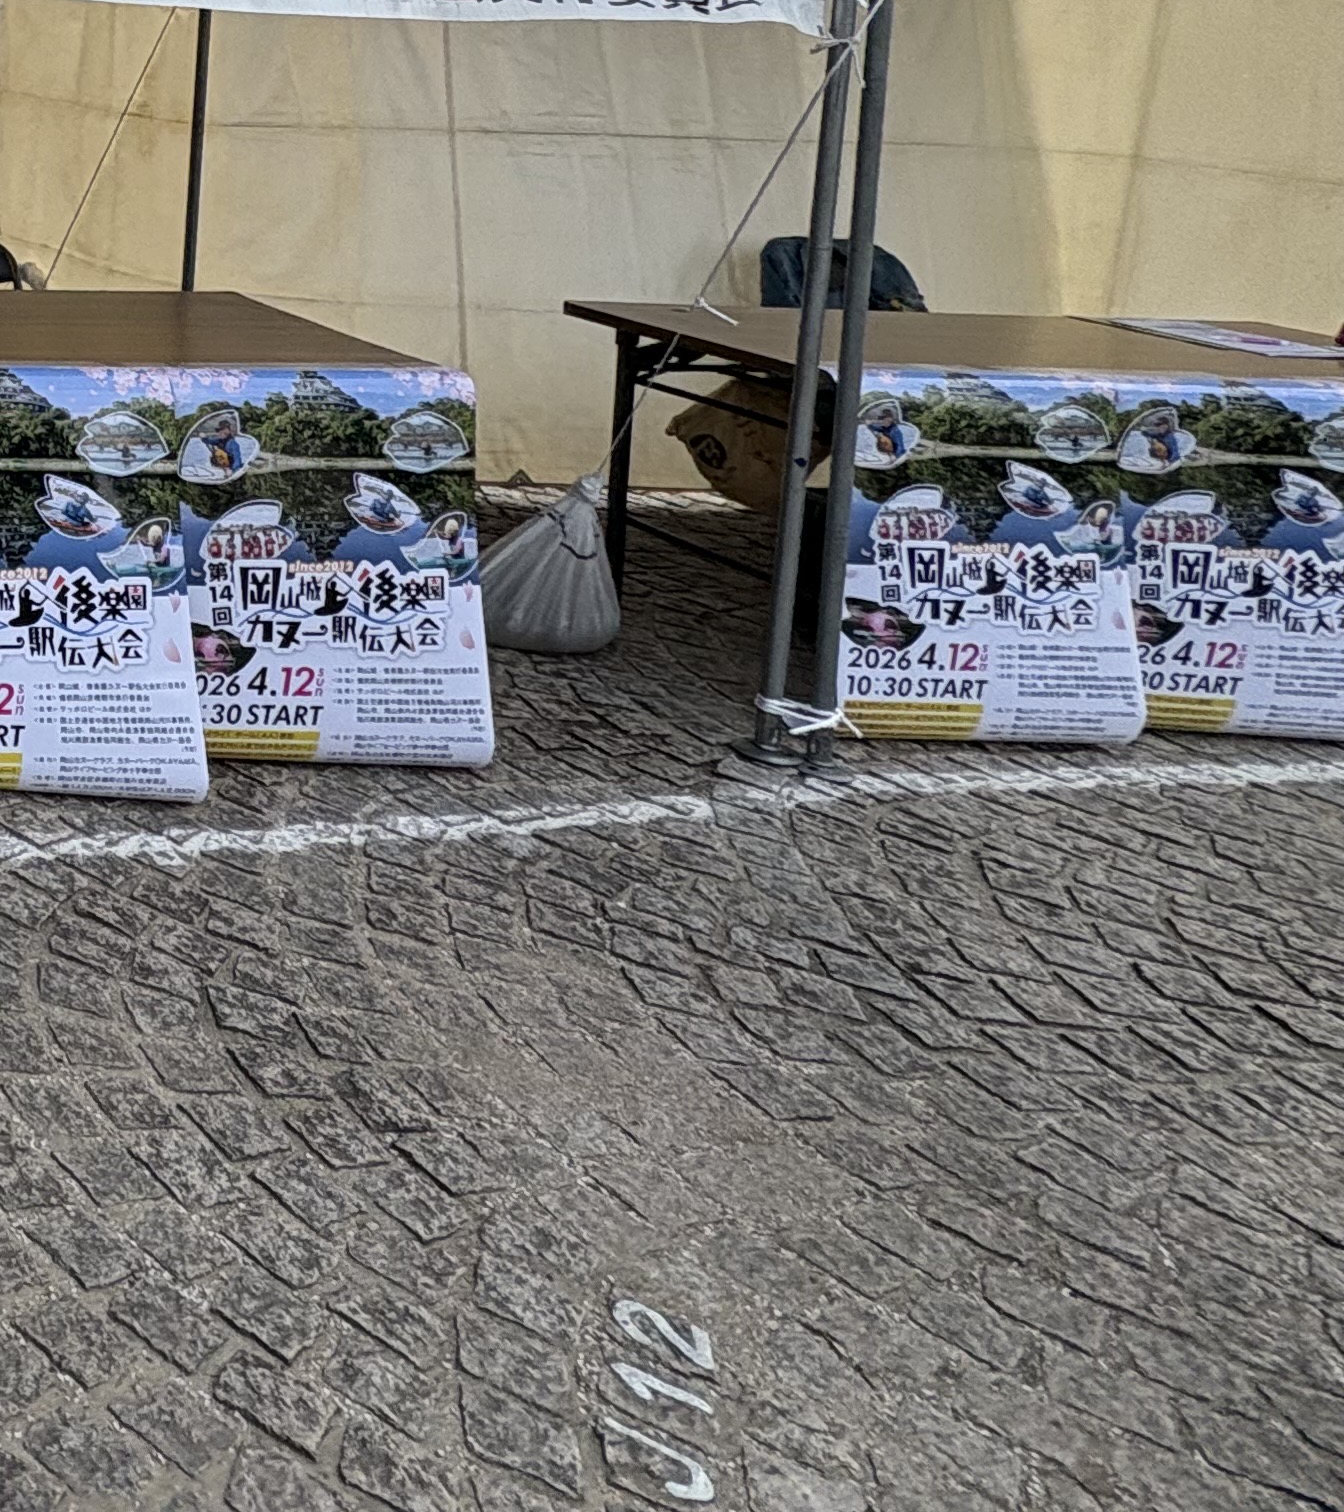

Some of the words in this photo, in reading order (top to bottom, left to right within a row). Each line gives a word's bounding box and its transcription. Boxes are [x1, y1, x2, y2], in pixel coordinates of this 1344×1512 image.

[1282, 556, 1344, 600] 後楽
[847, 646, 912, 671] 2026
[917, 643, 981, 671] 4.12
[1138, 644, 1166, 665] 26
[1171, 641, 1239, 670] 4.12
[196, 675, 241, 696] 026
[247, 667, 315, 697] 4.12
[846, 675, 912, 697] 10:30
[915, 677, 990, 701] START
[1167, 673, 1243, 696] START
[202, 704, 242, 725] :30
[246, 704, 324, 726] START
